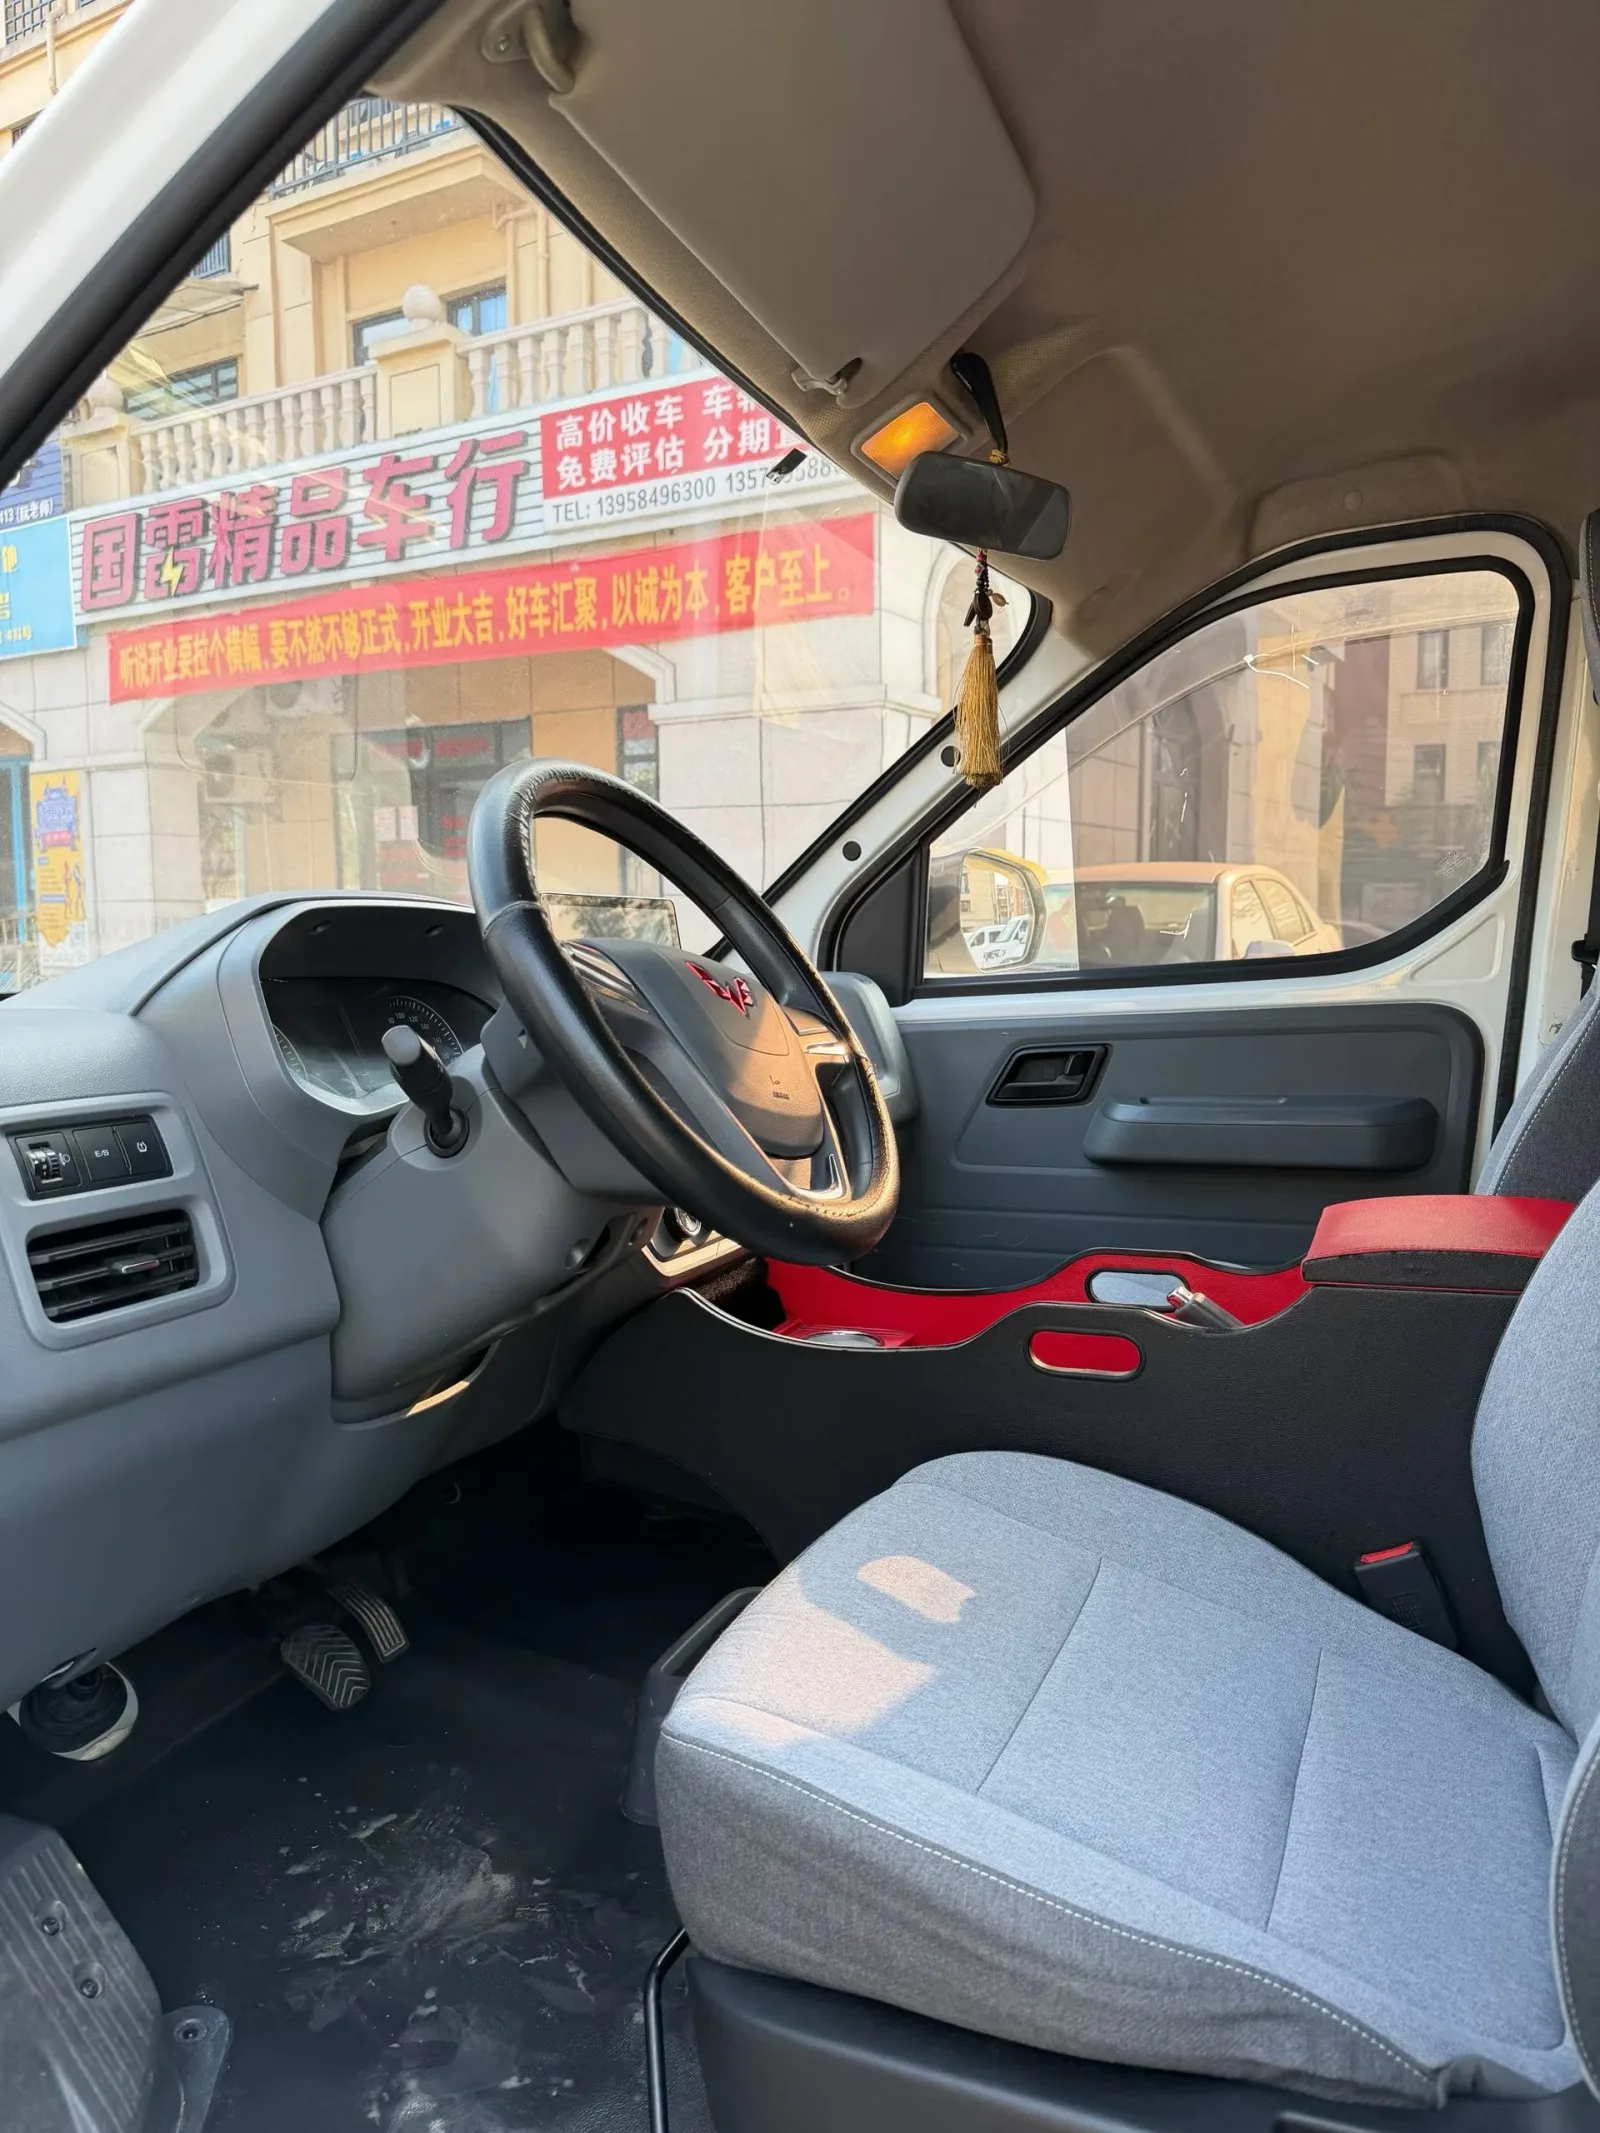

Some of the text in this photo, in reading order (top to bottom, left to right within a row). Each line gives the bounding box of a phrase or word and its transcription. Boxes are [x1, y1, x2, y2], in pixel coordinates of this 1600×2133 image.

[555, 393, 685, 451] 高价收车
[556, 433, 686, 491] 免费评估
[80, 429, 528, 612] 国雷精品车行
[552, 500, 591, 524] TEL:
[596, 475, 716, 518] 13958496300
